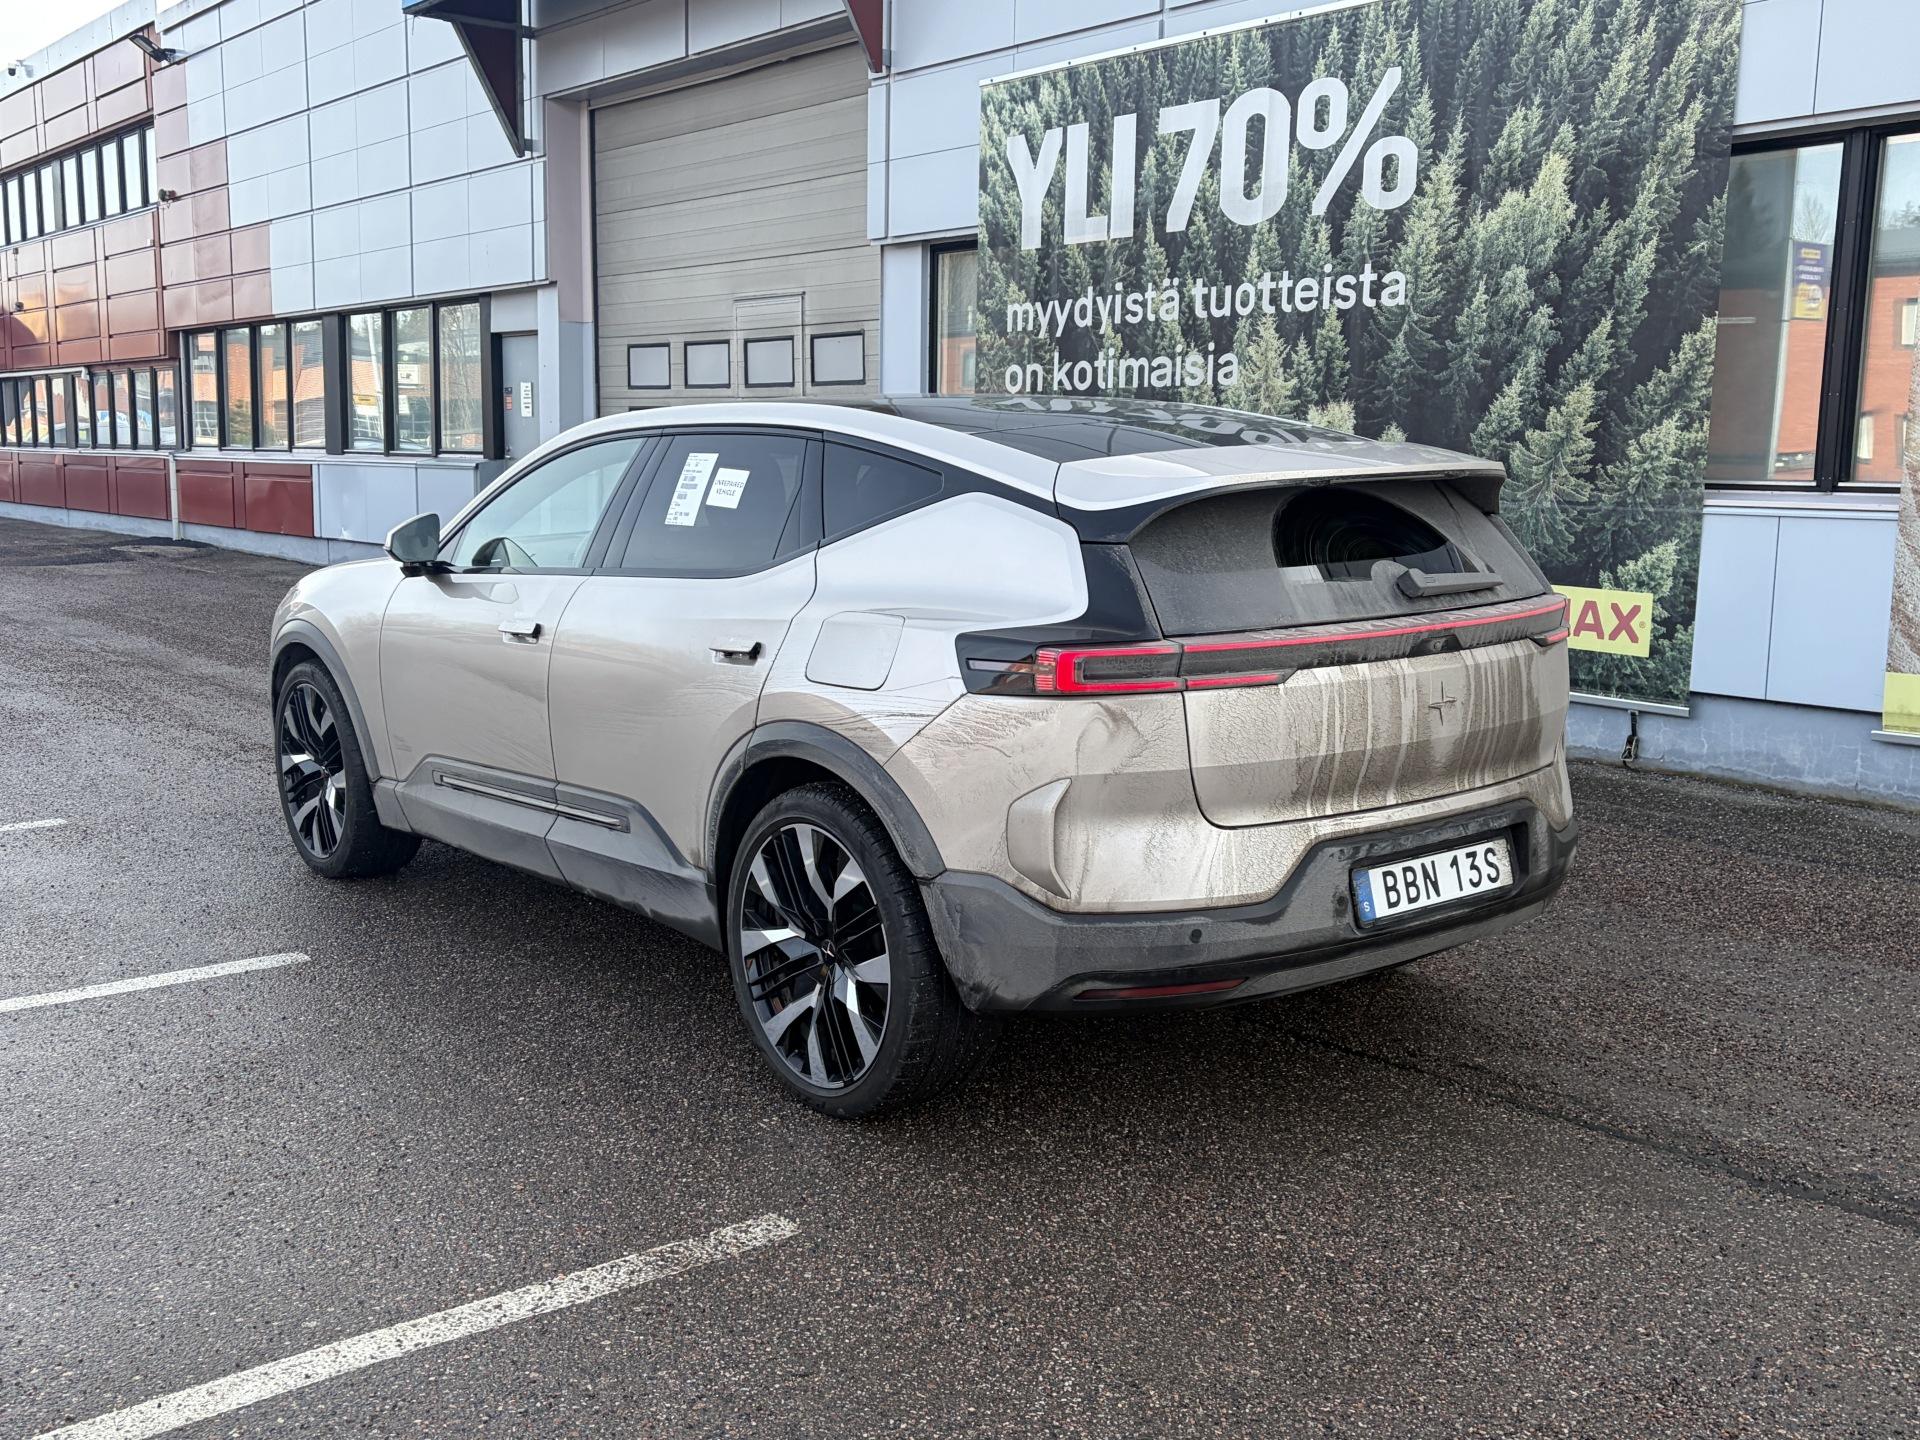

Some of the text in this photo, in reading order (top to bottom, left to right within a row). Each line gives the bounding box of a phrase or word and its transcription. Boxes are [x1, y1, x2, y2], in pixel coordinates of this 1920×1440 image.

[1007, 66, 1418, 250] YLI 70%
[1006, 263, 1406, 338] myydyistä tuotteista
[1005, 342, 1239, 394] on kotimaisia
[1561, 599, 1641, 643] AX
[1363, 901, 1371, 912] S
[1382, 847, 1500, 909] BBN 13S
